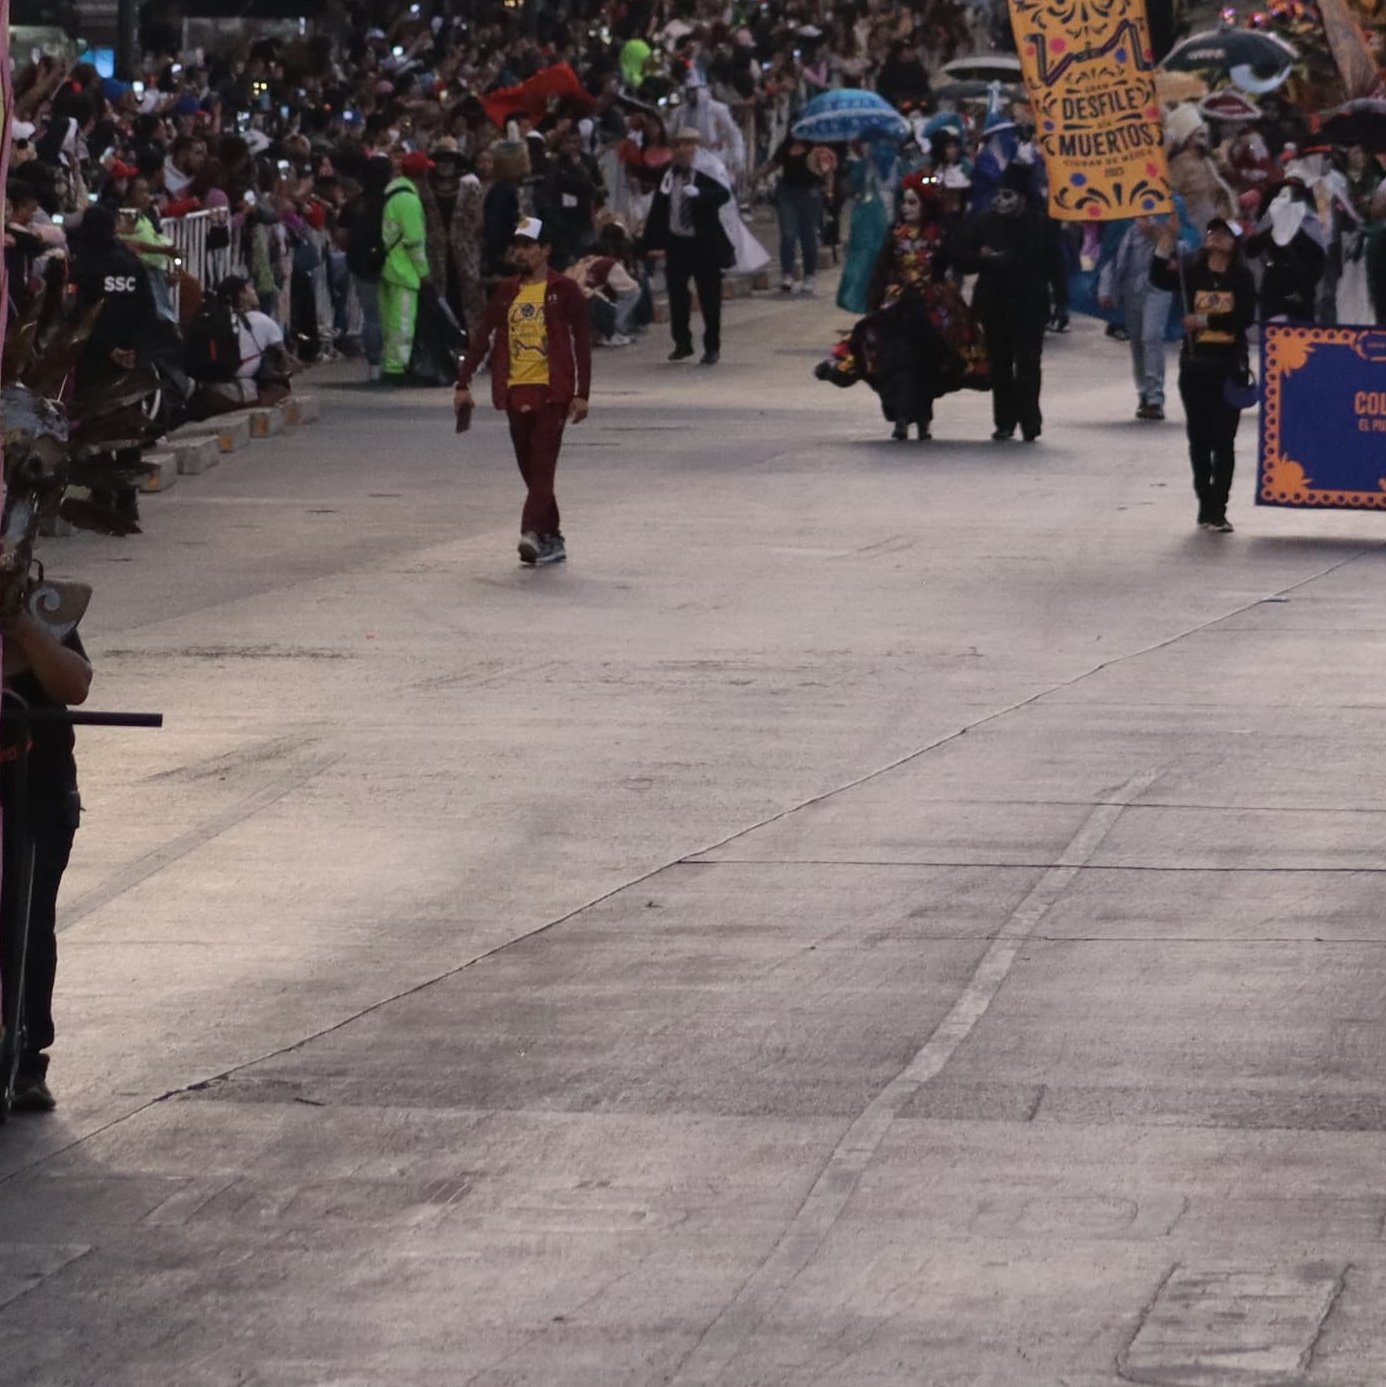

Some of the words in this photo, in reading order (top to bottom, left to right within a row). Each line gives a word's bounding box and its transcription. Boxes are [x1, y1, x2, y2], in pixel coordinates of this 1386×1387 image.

[1061, 87, 1139, 120] DESFILE
[1059, 123, 1154, 156] MUERTOS
[104, 275, 137, 292] SSC
[1358, 418, 1370, 431] EL
